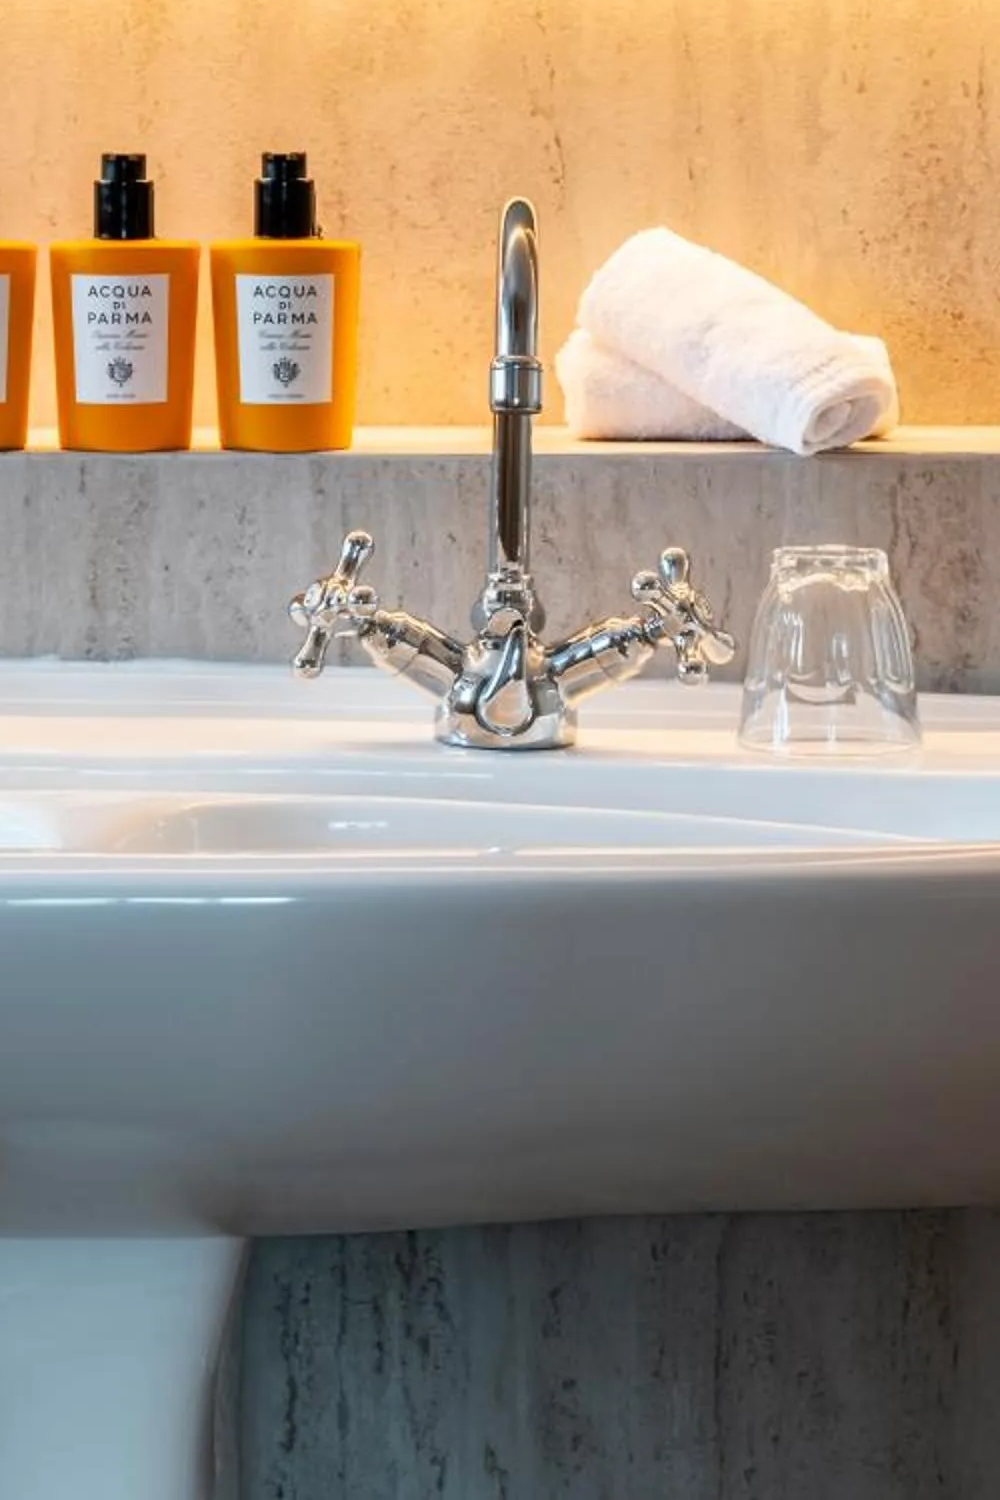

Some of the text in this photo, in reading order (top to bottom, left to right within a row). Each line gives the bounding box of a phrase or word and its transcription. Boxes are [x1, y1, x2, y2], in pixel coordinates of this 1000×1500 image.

[87, 284, 153, 299] ACQUA
[253, 284, 318, 299] ACQUA
[112, 301, 126, 311] DI
[278, 301, 292, 311] DI
[87, 311, 153, 325] PARMA
[253, 312, 318, 325] PARMA
